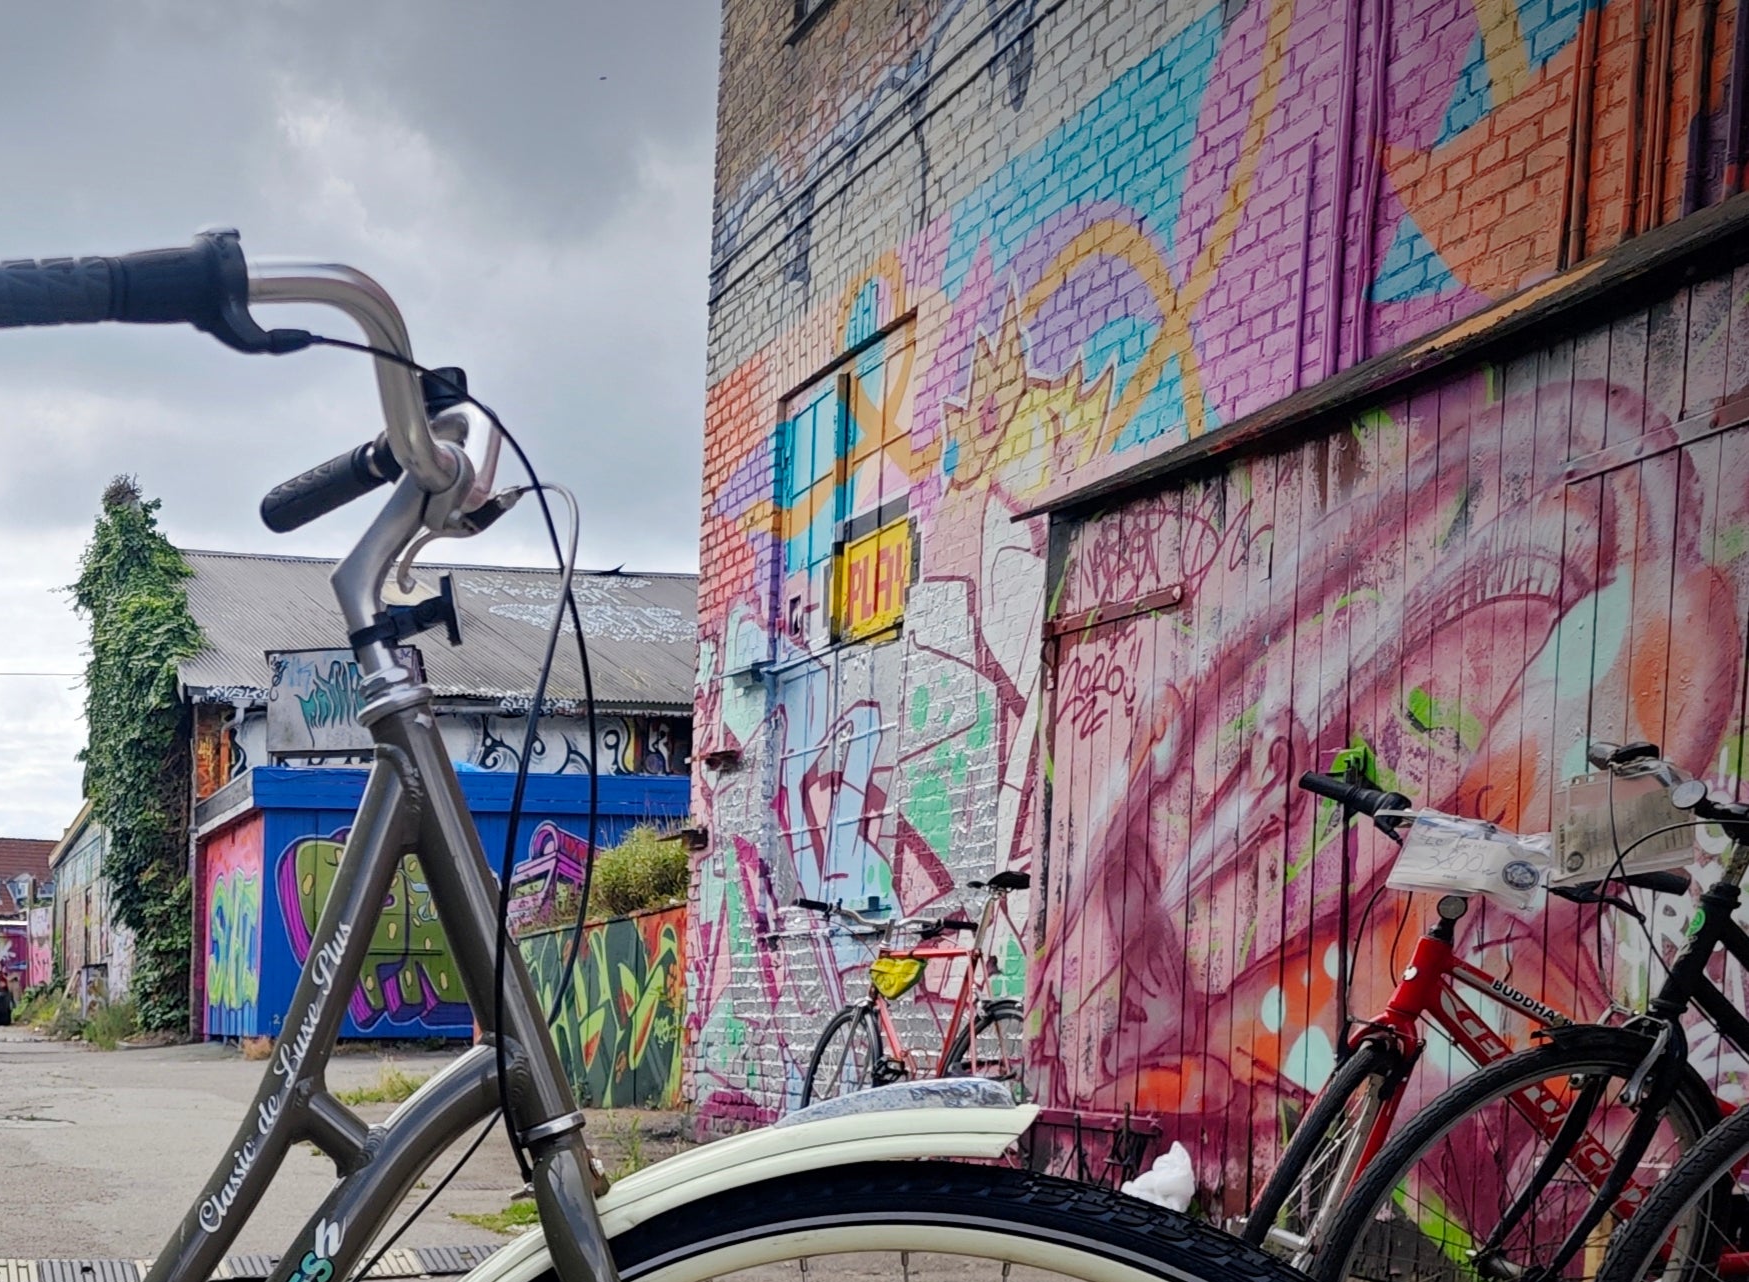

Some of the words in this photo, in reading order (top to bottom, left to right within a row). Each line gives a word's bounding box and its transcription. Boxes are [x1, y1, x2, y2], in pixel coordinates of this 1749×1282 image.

[199, 1138, 257, 1233] Classic
[258, 1092, 281, 1136] de
[273, 1000, 320, 1089] Luxe
[312, 920, 351, 995] Plus
[1492, 979, 1556, 1022] BUDDHA
